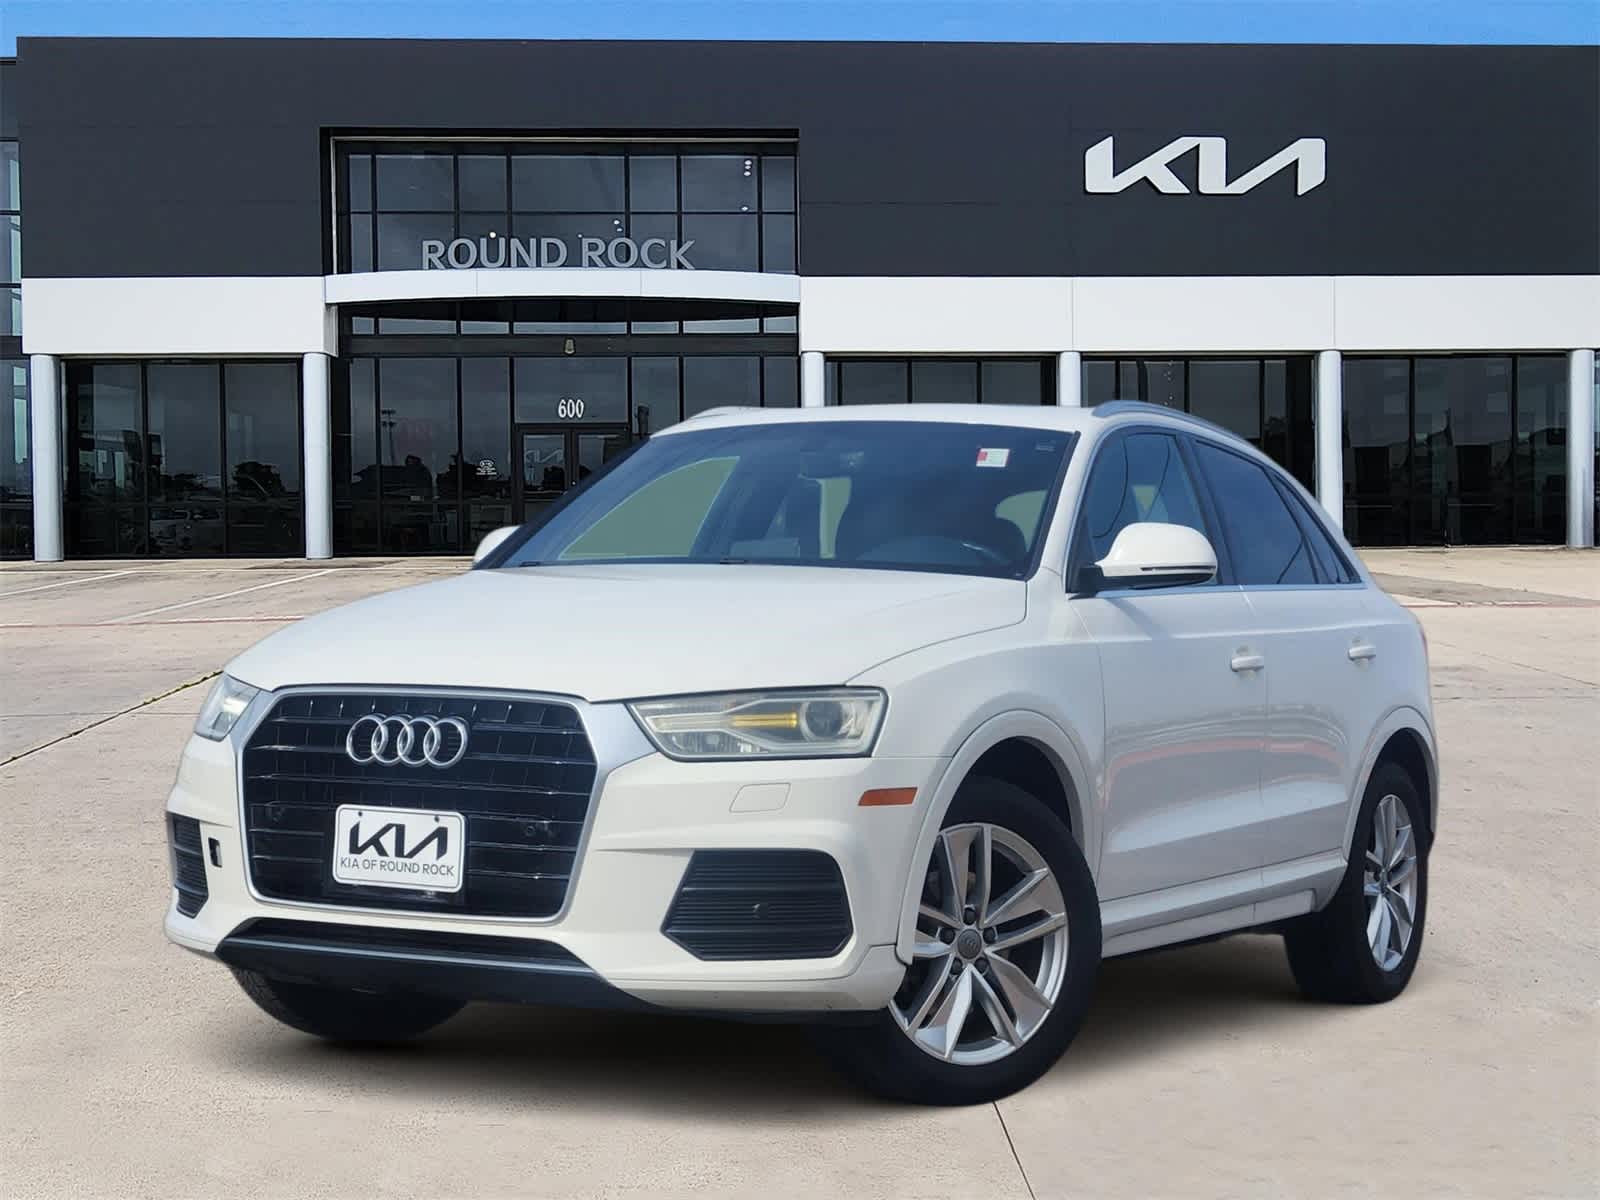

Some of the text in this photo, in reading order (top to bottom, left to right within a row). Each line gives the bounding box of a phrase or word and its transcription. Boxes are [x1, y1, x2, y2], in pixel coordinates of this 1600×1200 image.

[422, 236, 696, 270] ROUND ROCK
[558, 399, 585, 418] 600
[340, 857, 455, 877] KIA OF ROUND ROCK
